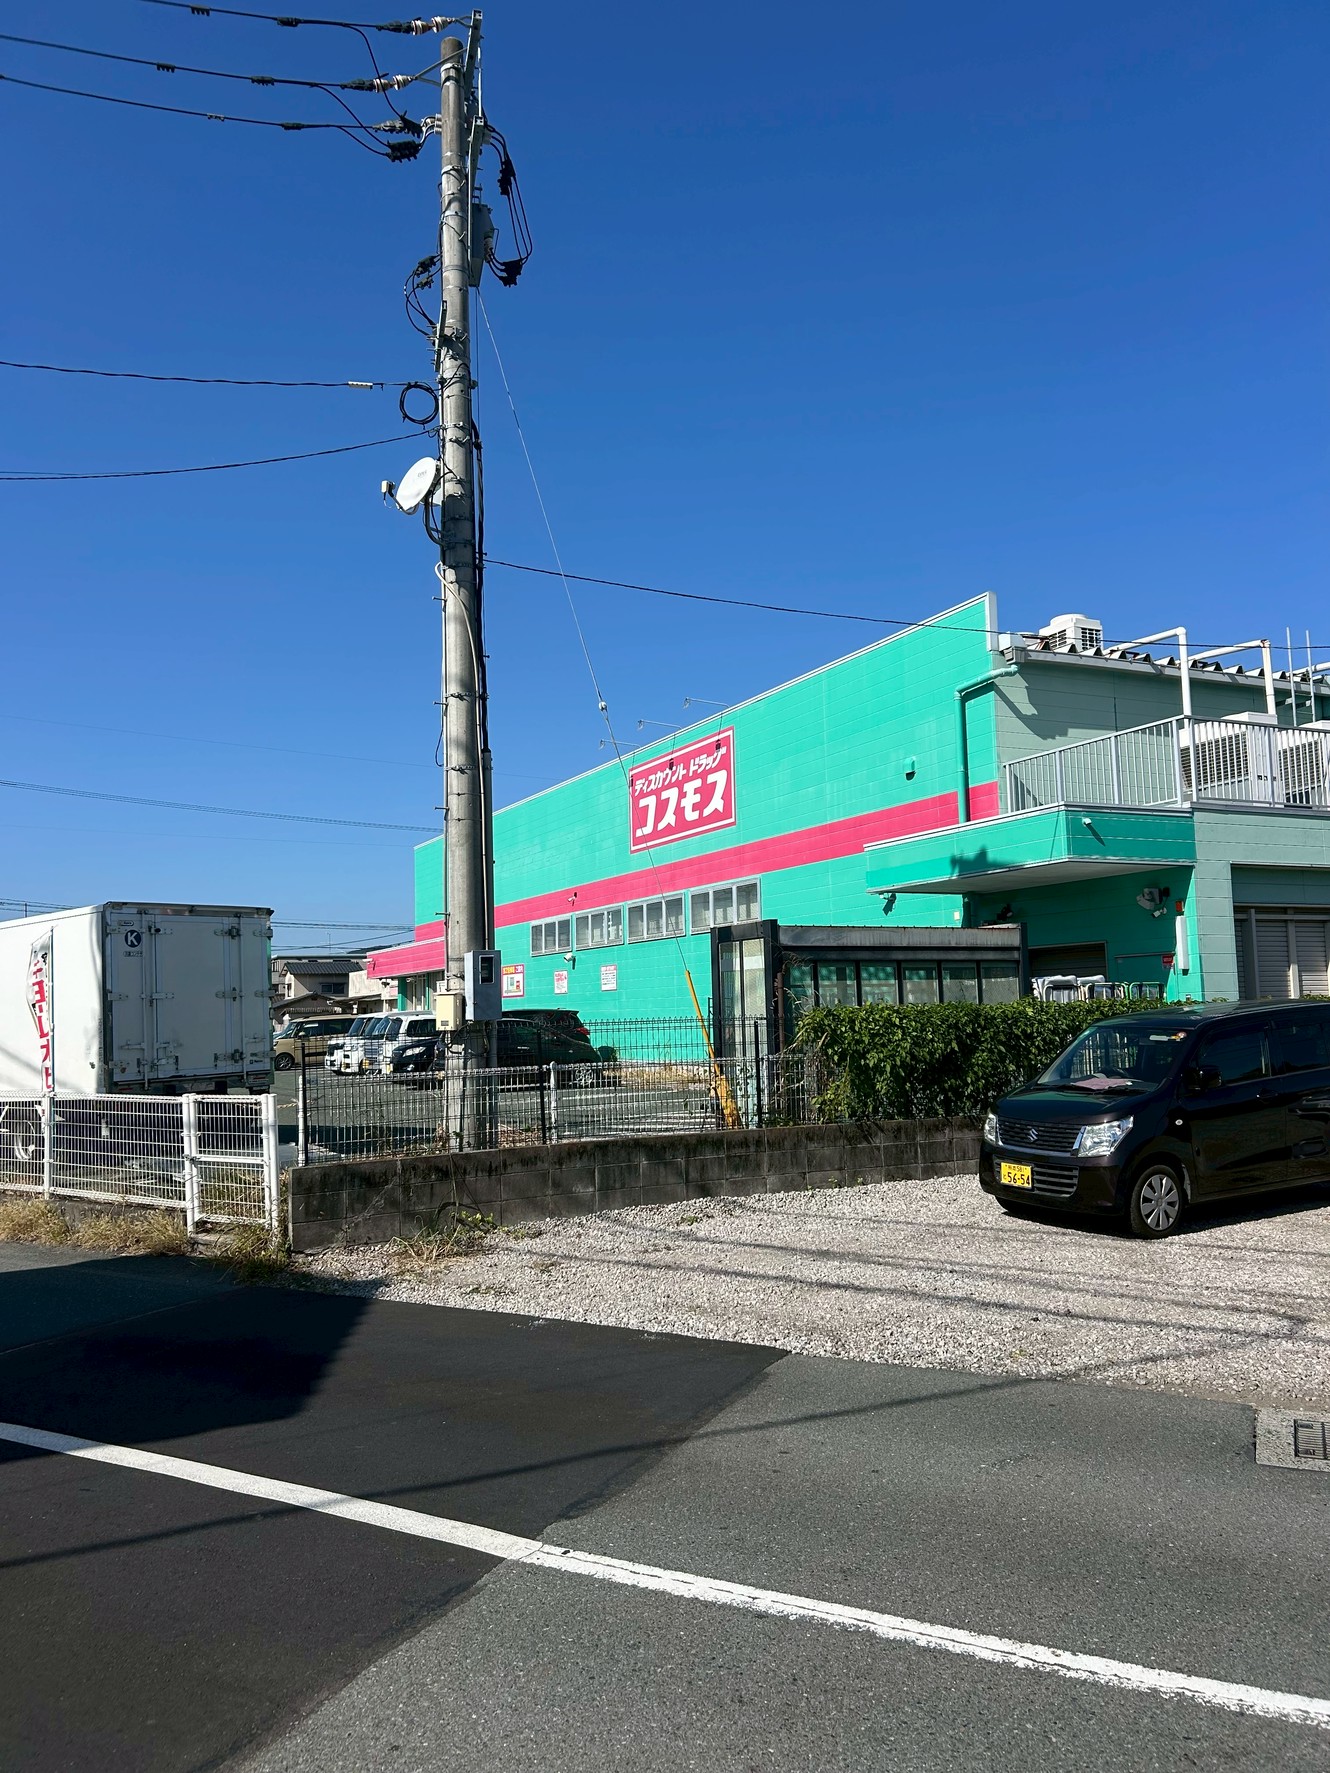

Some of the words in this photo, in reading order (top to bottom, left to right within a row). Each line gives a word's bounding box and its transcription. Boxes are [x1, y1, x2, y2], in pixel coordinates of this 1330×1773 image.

[634, 763, 687, 796] ディスカウント
[689, 746, 727, 776] ドラッグ
[635, 769, 728, 838] コスモス
[127, 932, 138, 946] K
[1007, 1171, 1030, 1186] 56-54
